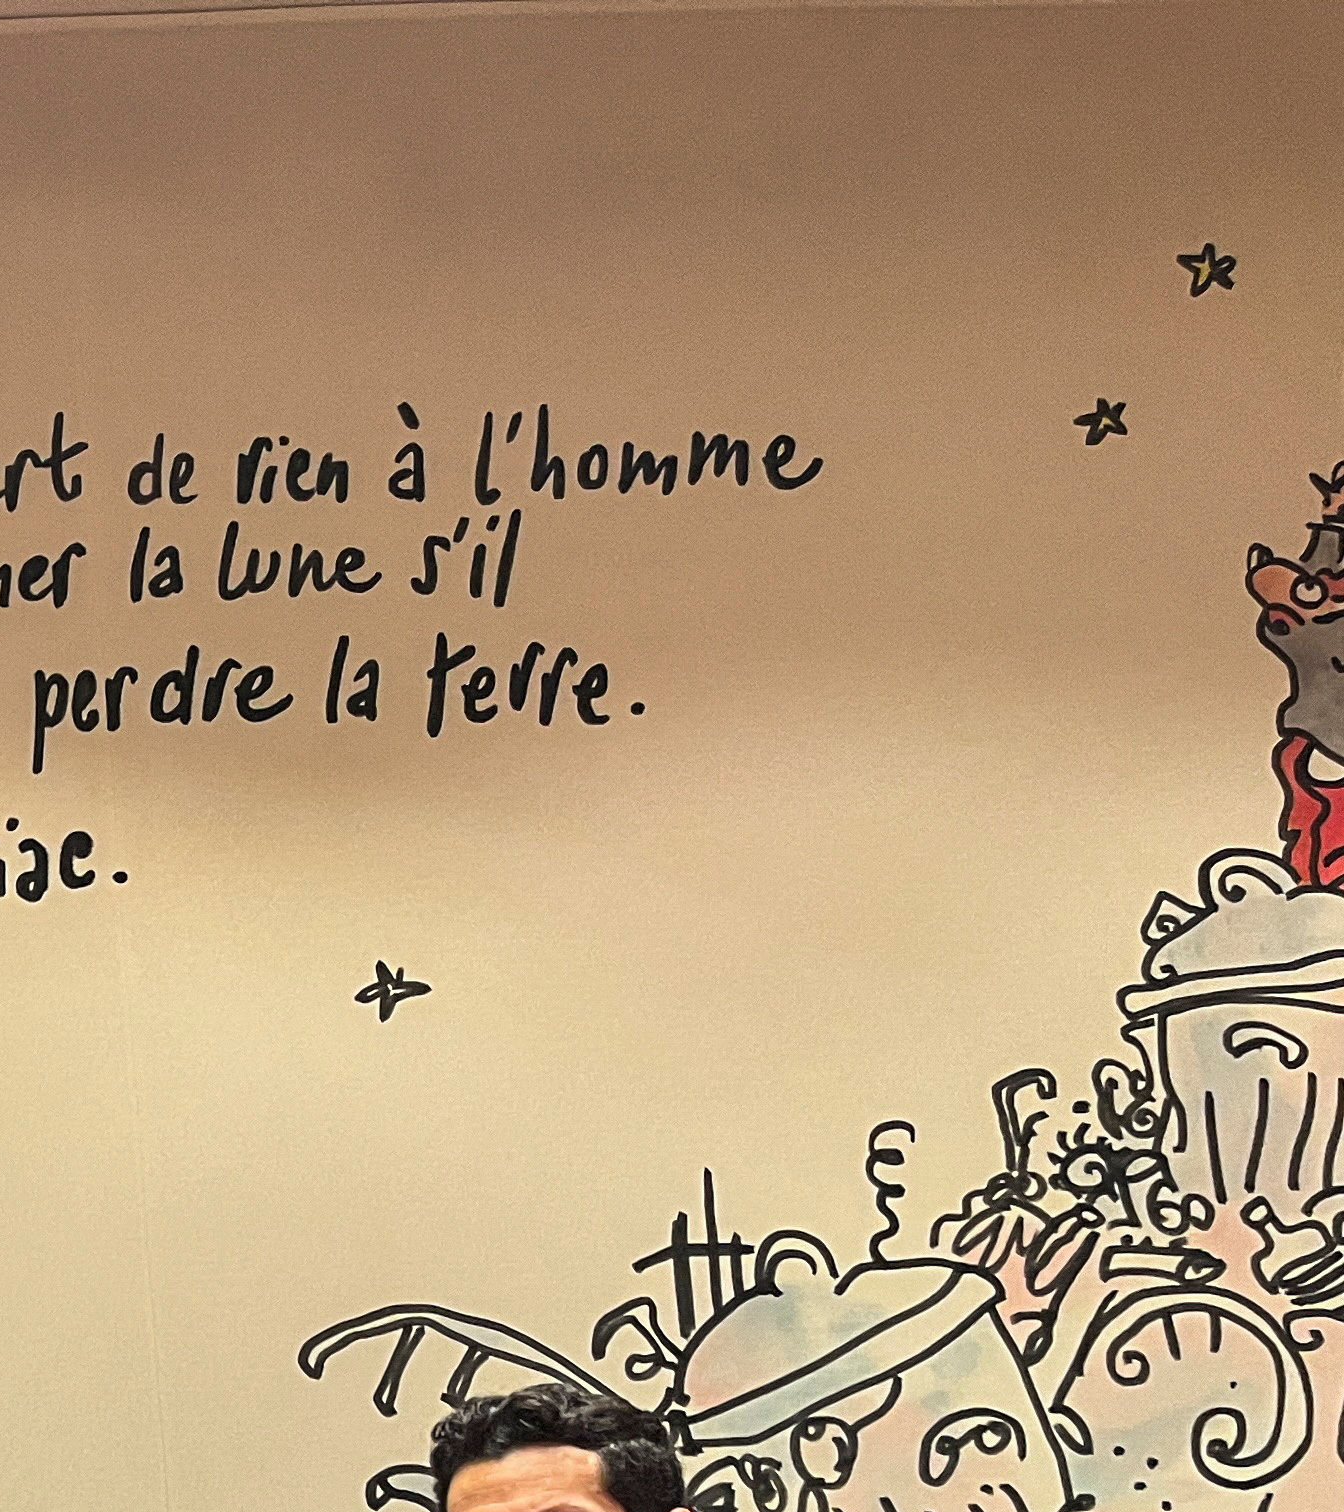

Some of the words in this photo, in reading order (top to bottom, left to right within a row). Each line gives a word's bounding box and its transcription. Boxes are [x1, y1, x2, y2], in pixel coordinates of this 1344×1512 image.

[127, 433, 199, 507] de
[235, 434, 349, 504] rien
[387, 401, 427, 503] à
[476, 403, 824, 508] l'homme
[131, 528, 182, 604] la
[219, 521, 382, 601] lune
[411, 508, 522, 608] s'il
[33, 645, 293, 774] perdre
[326, 635, 380, 723] la
[427, 633, 646, 738] terre.
